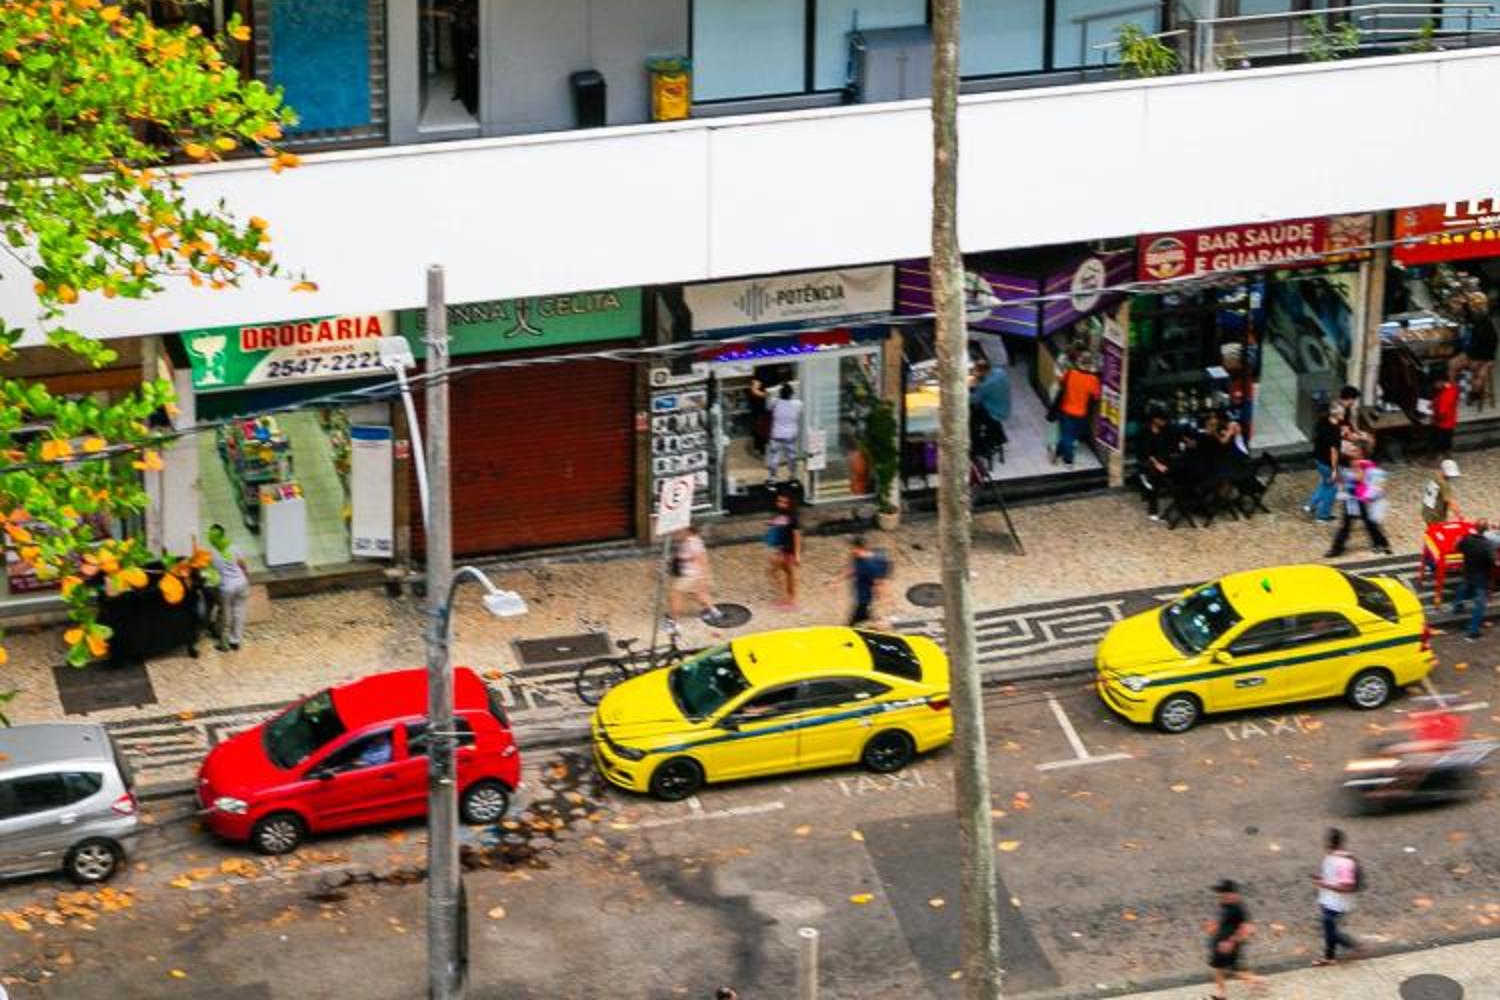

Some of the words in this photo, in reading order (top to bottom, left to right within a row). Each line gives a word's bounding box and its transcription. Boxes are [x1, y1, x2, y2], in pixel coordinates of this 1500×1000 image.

[1197, 231, 1240, 252] BAR
[1194, 256, 1208, 276] E
[242, 315, 382, 351] DROGARIA
